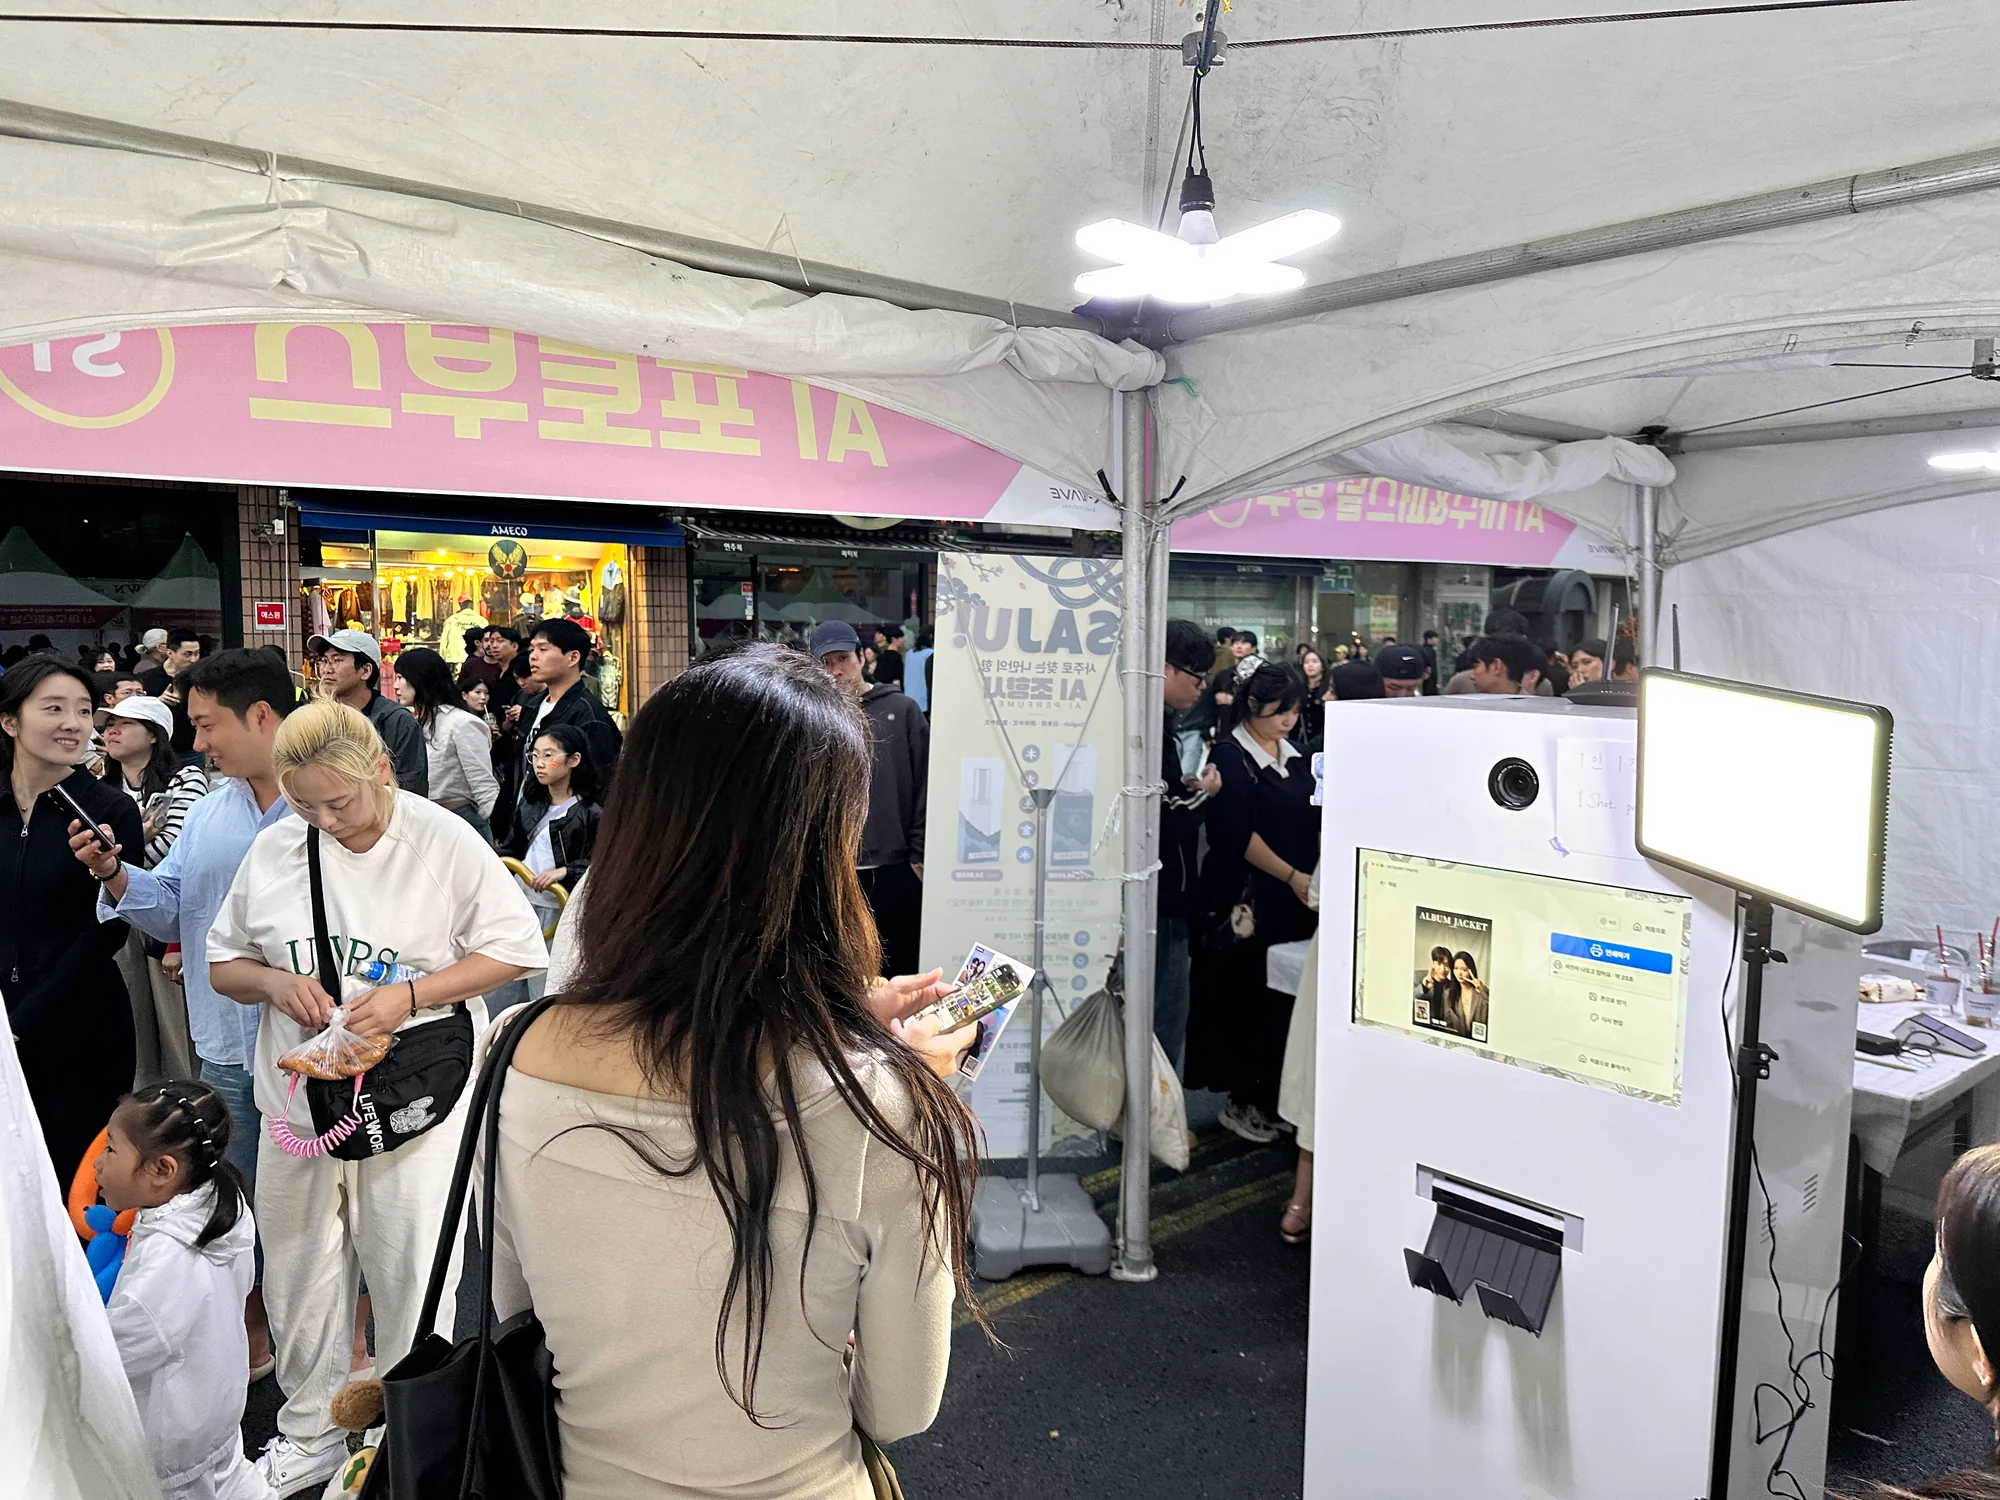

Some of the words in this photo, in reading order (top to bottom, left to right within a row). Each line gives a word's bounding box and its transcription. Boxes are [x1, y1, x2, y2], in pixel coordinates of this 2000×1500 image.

[491, 525, 528, 536] AMECO
[1420, 911, 1451, 925] ALBUM
[1453, 917, 1488, 931] JACKET
[359, 1093, 385, 1155] LIFEWOR
